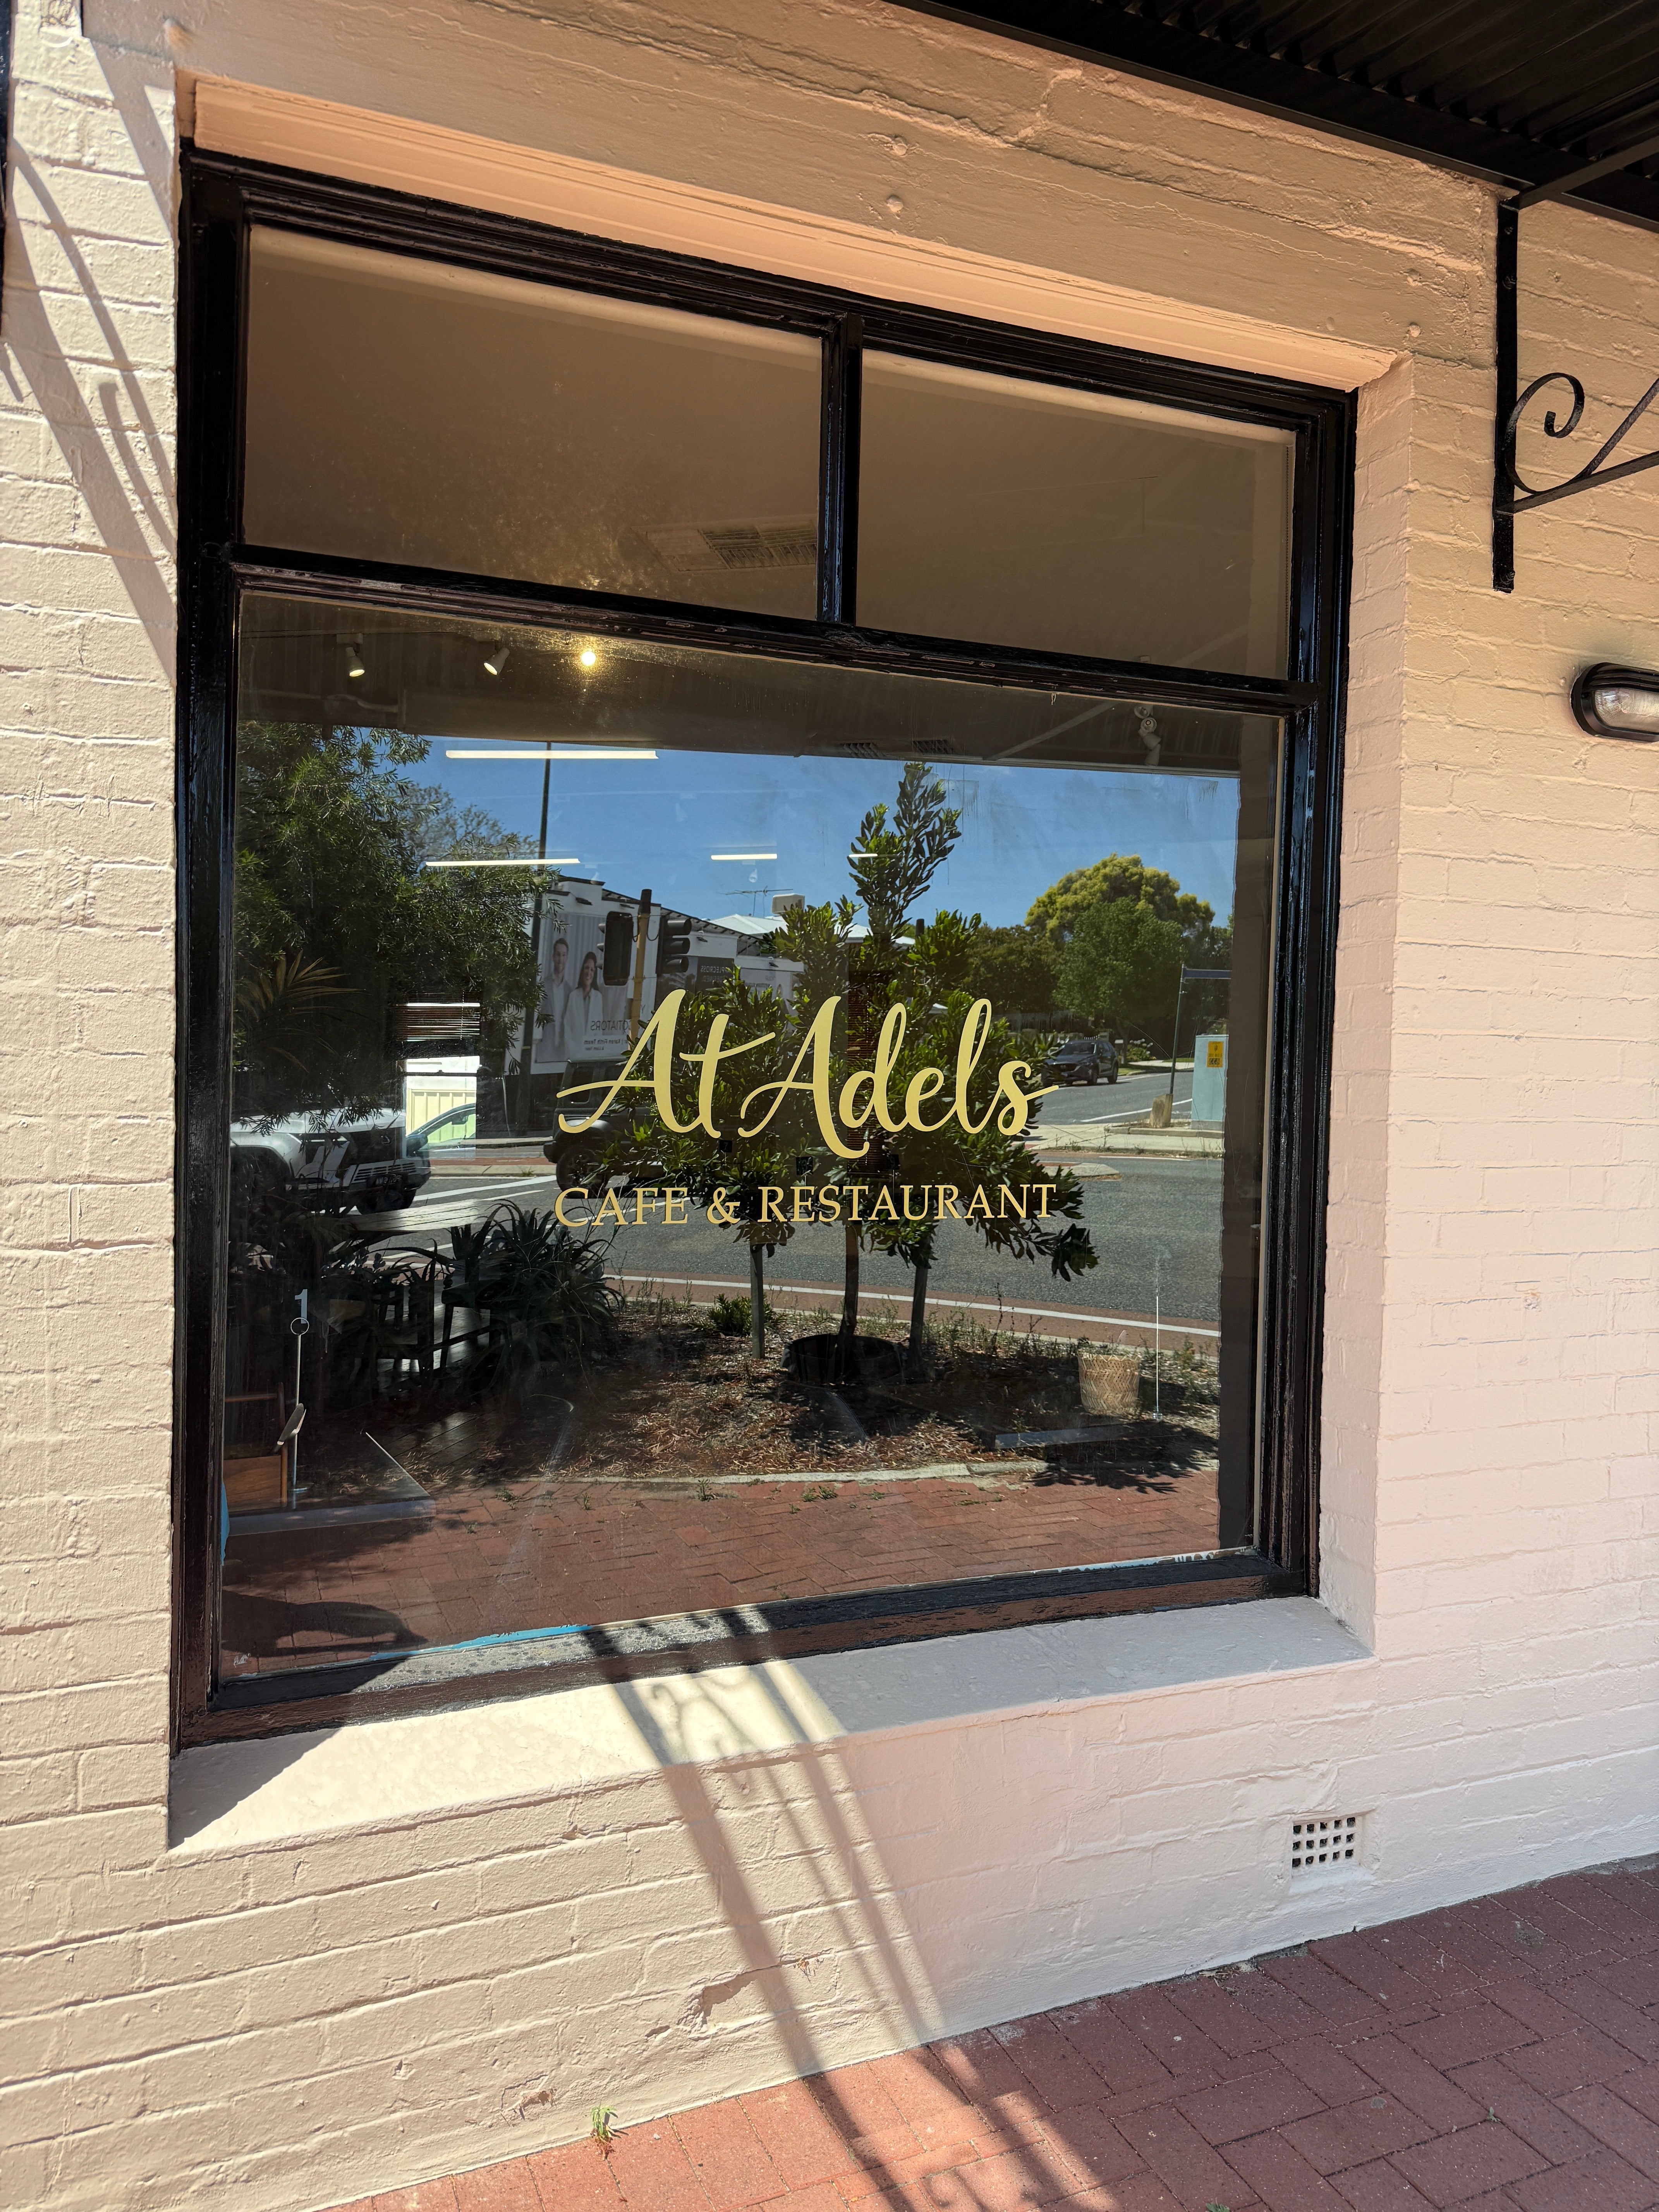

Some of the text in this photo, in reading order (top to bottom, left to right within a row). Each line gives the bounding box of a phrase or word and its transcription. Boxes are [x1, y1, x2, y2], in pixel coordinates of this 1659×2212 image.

[556, 989, 1059, 1159] At Adels
[555, 1183, 1057, 1227] CAFE & RESTAURANT
[294, 1289, 308, 1324] 1
